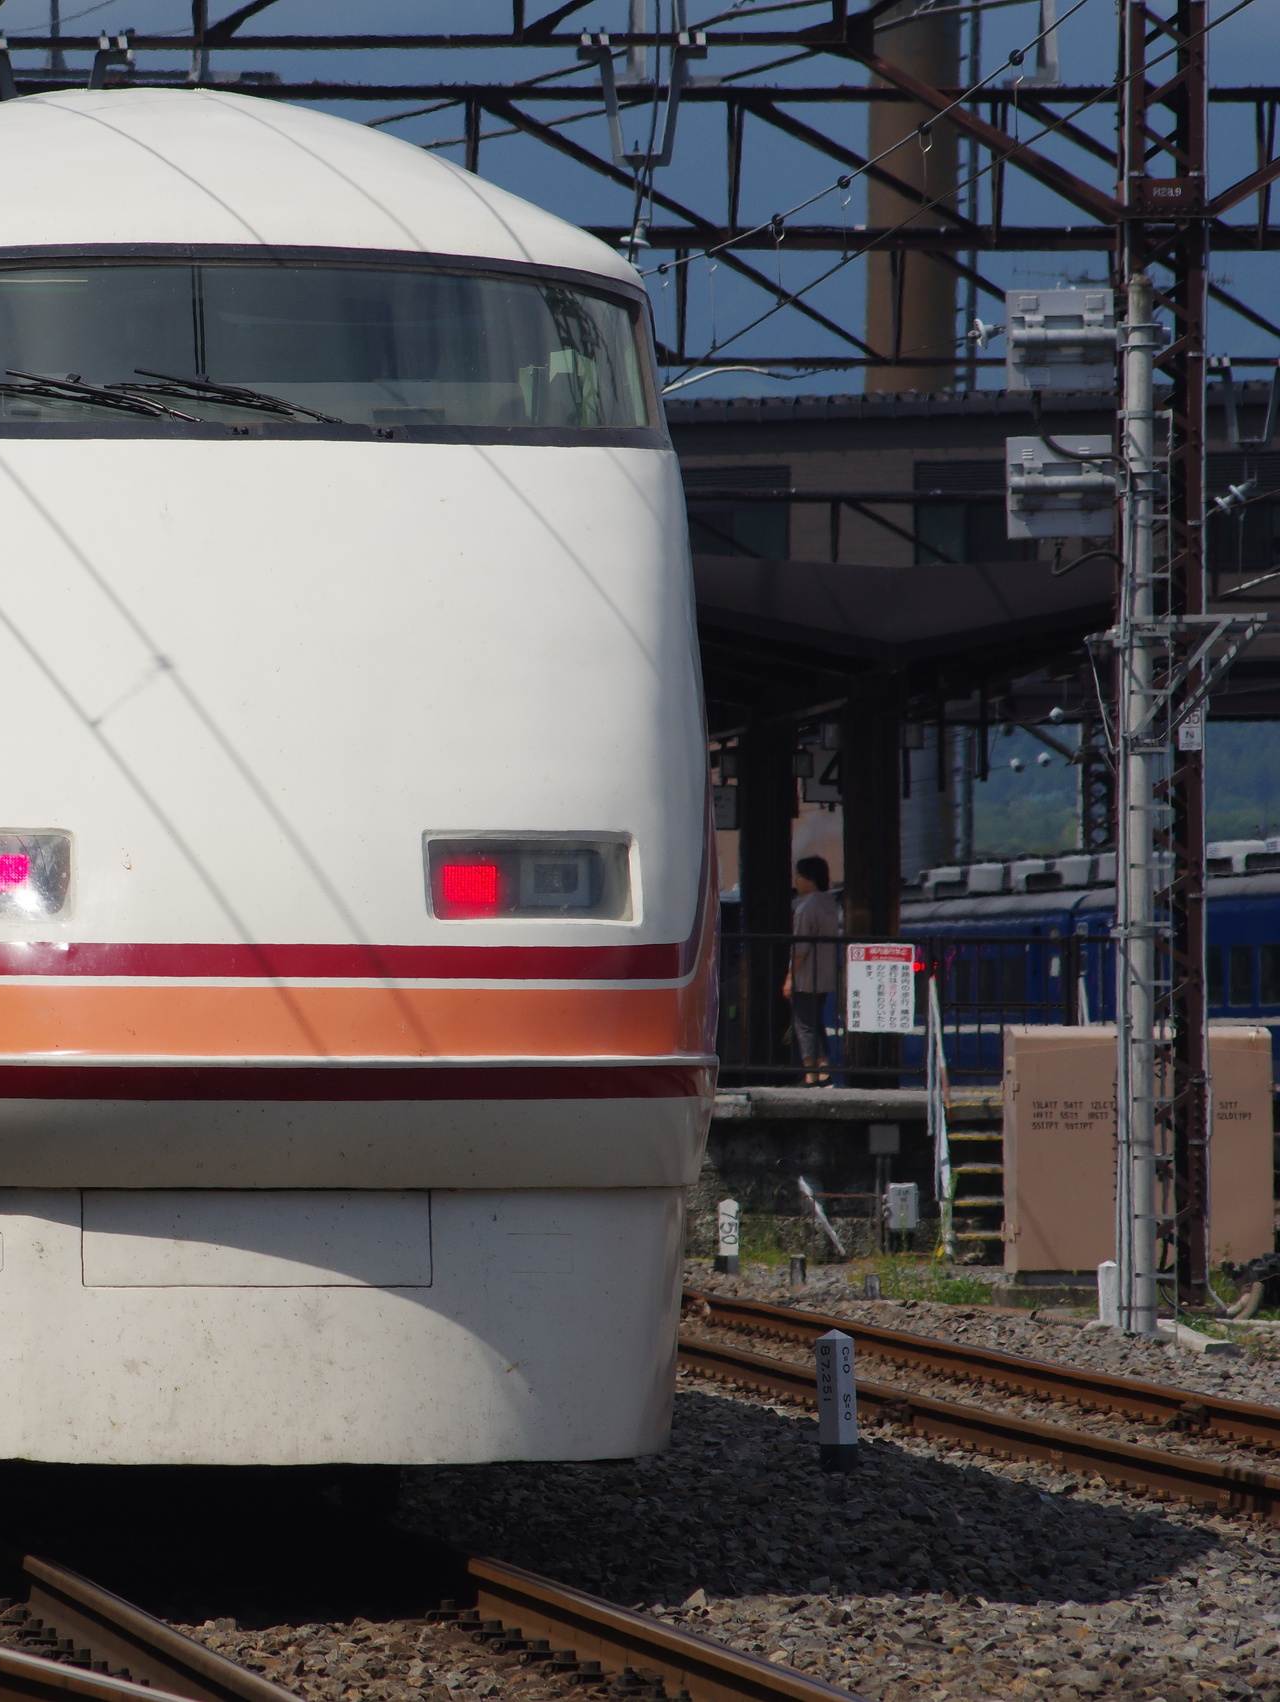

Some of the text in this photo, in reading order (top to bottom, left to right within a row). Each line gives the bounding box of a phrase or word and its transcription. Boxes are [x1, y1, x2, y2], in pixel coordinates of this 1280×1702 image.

[820, 750, 842, 795] 4
[720, 1211, 739, 1245] 750
[820, 1345, 832, 1402] 87.251
